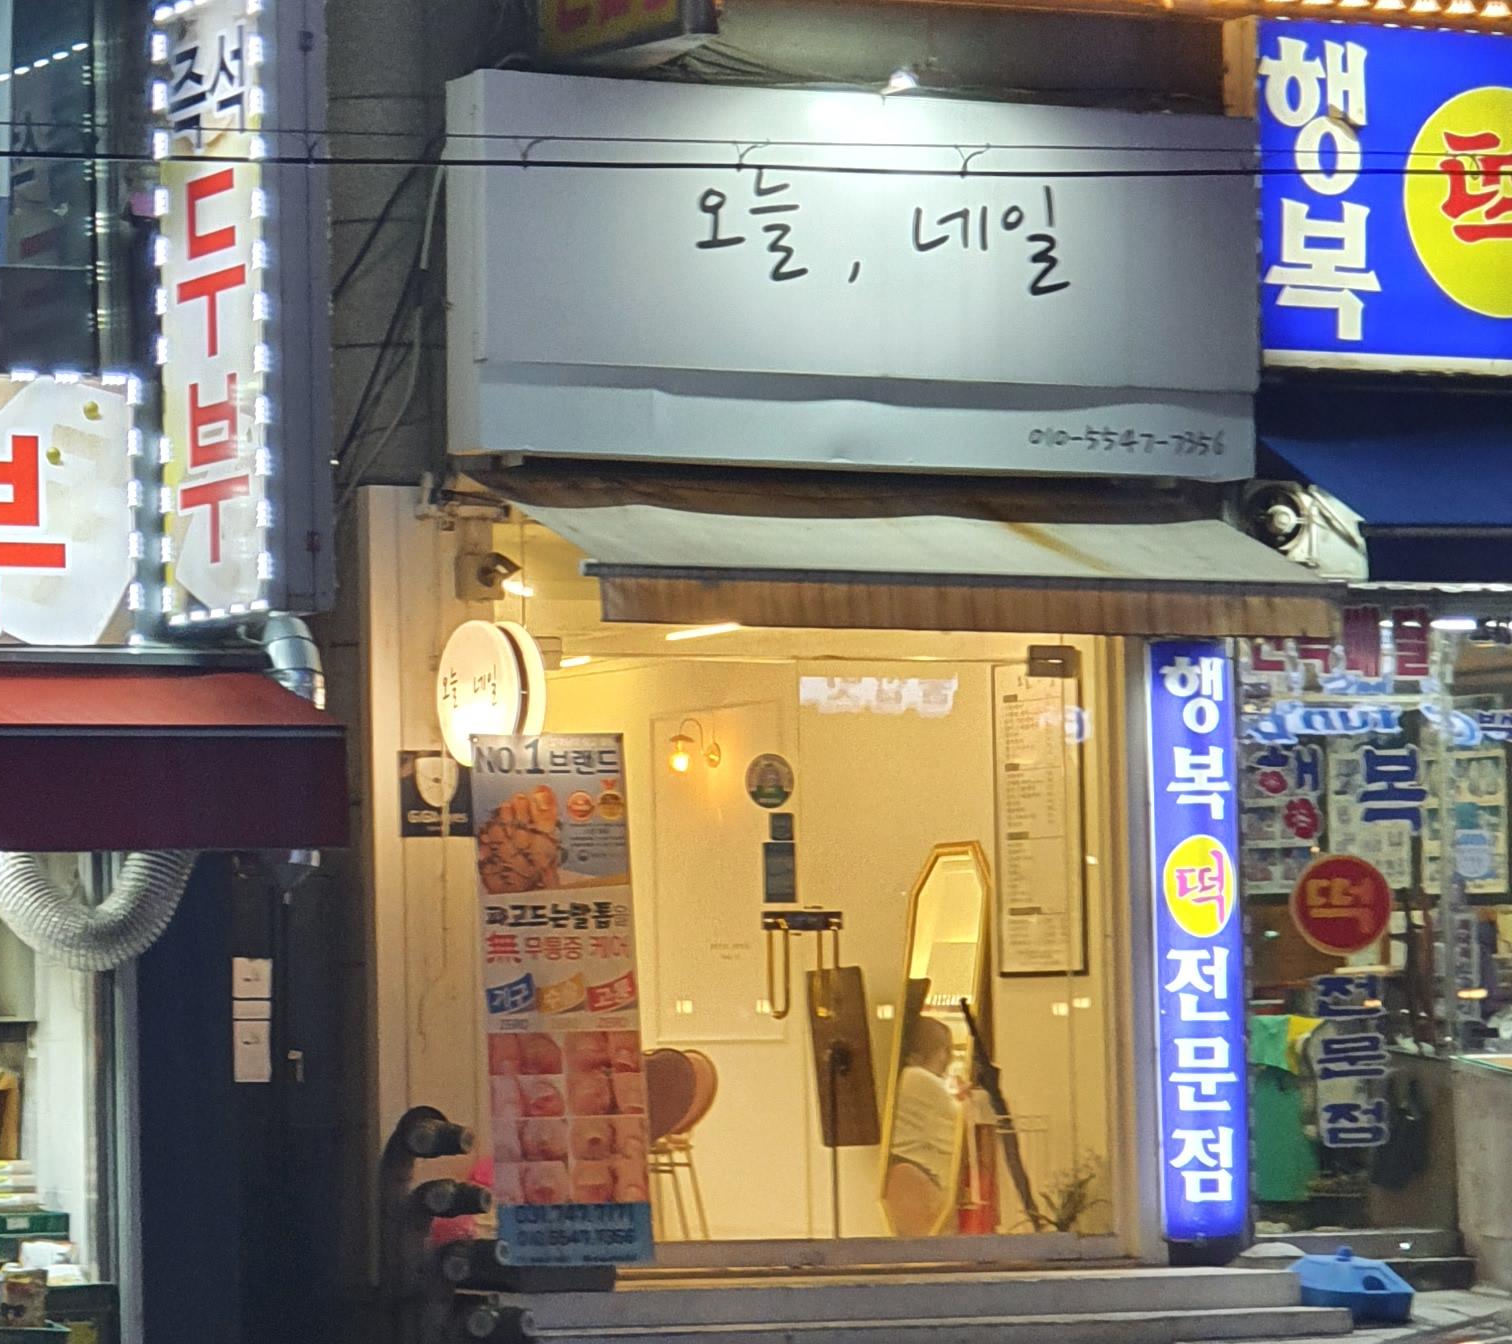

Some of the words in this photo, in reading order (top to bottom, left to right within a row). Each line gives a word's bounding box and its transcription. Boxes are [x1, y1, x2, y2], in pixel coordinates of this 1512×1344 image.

[912, 184, 1071, 296] 네일
[1257, 36, 1382, 342] 행복
[177, 167, 250, 565] 두부
[474, 739, 545, 774] NO.1
[548, 750, 619, 775] 브랜드
[1160, 654, 1232, 822] 행복
[1175, 848, 1228, 925] 떡
[1163, 945, 1239, 1205] 전문점
